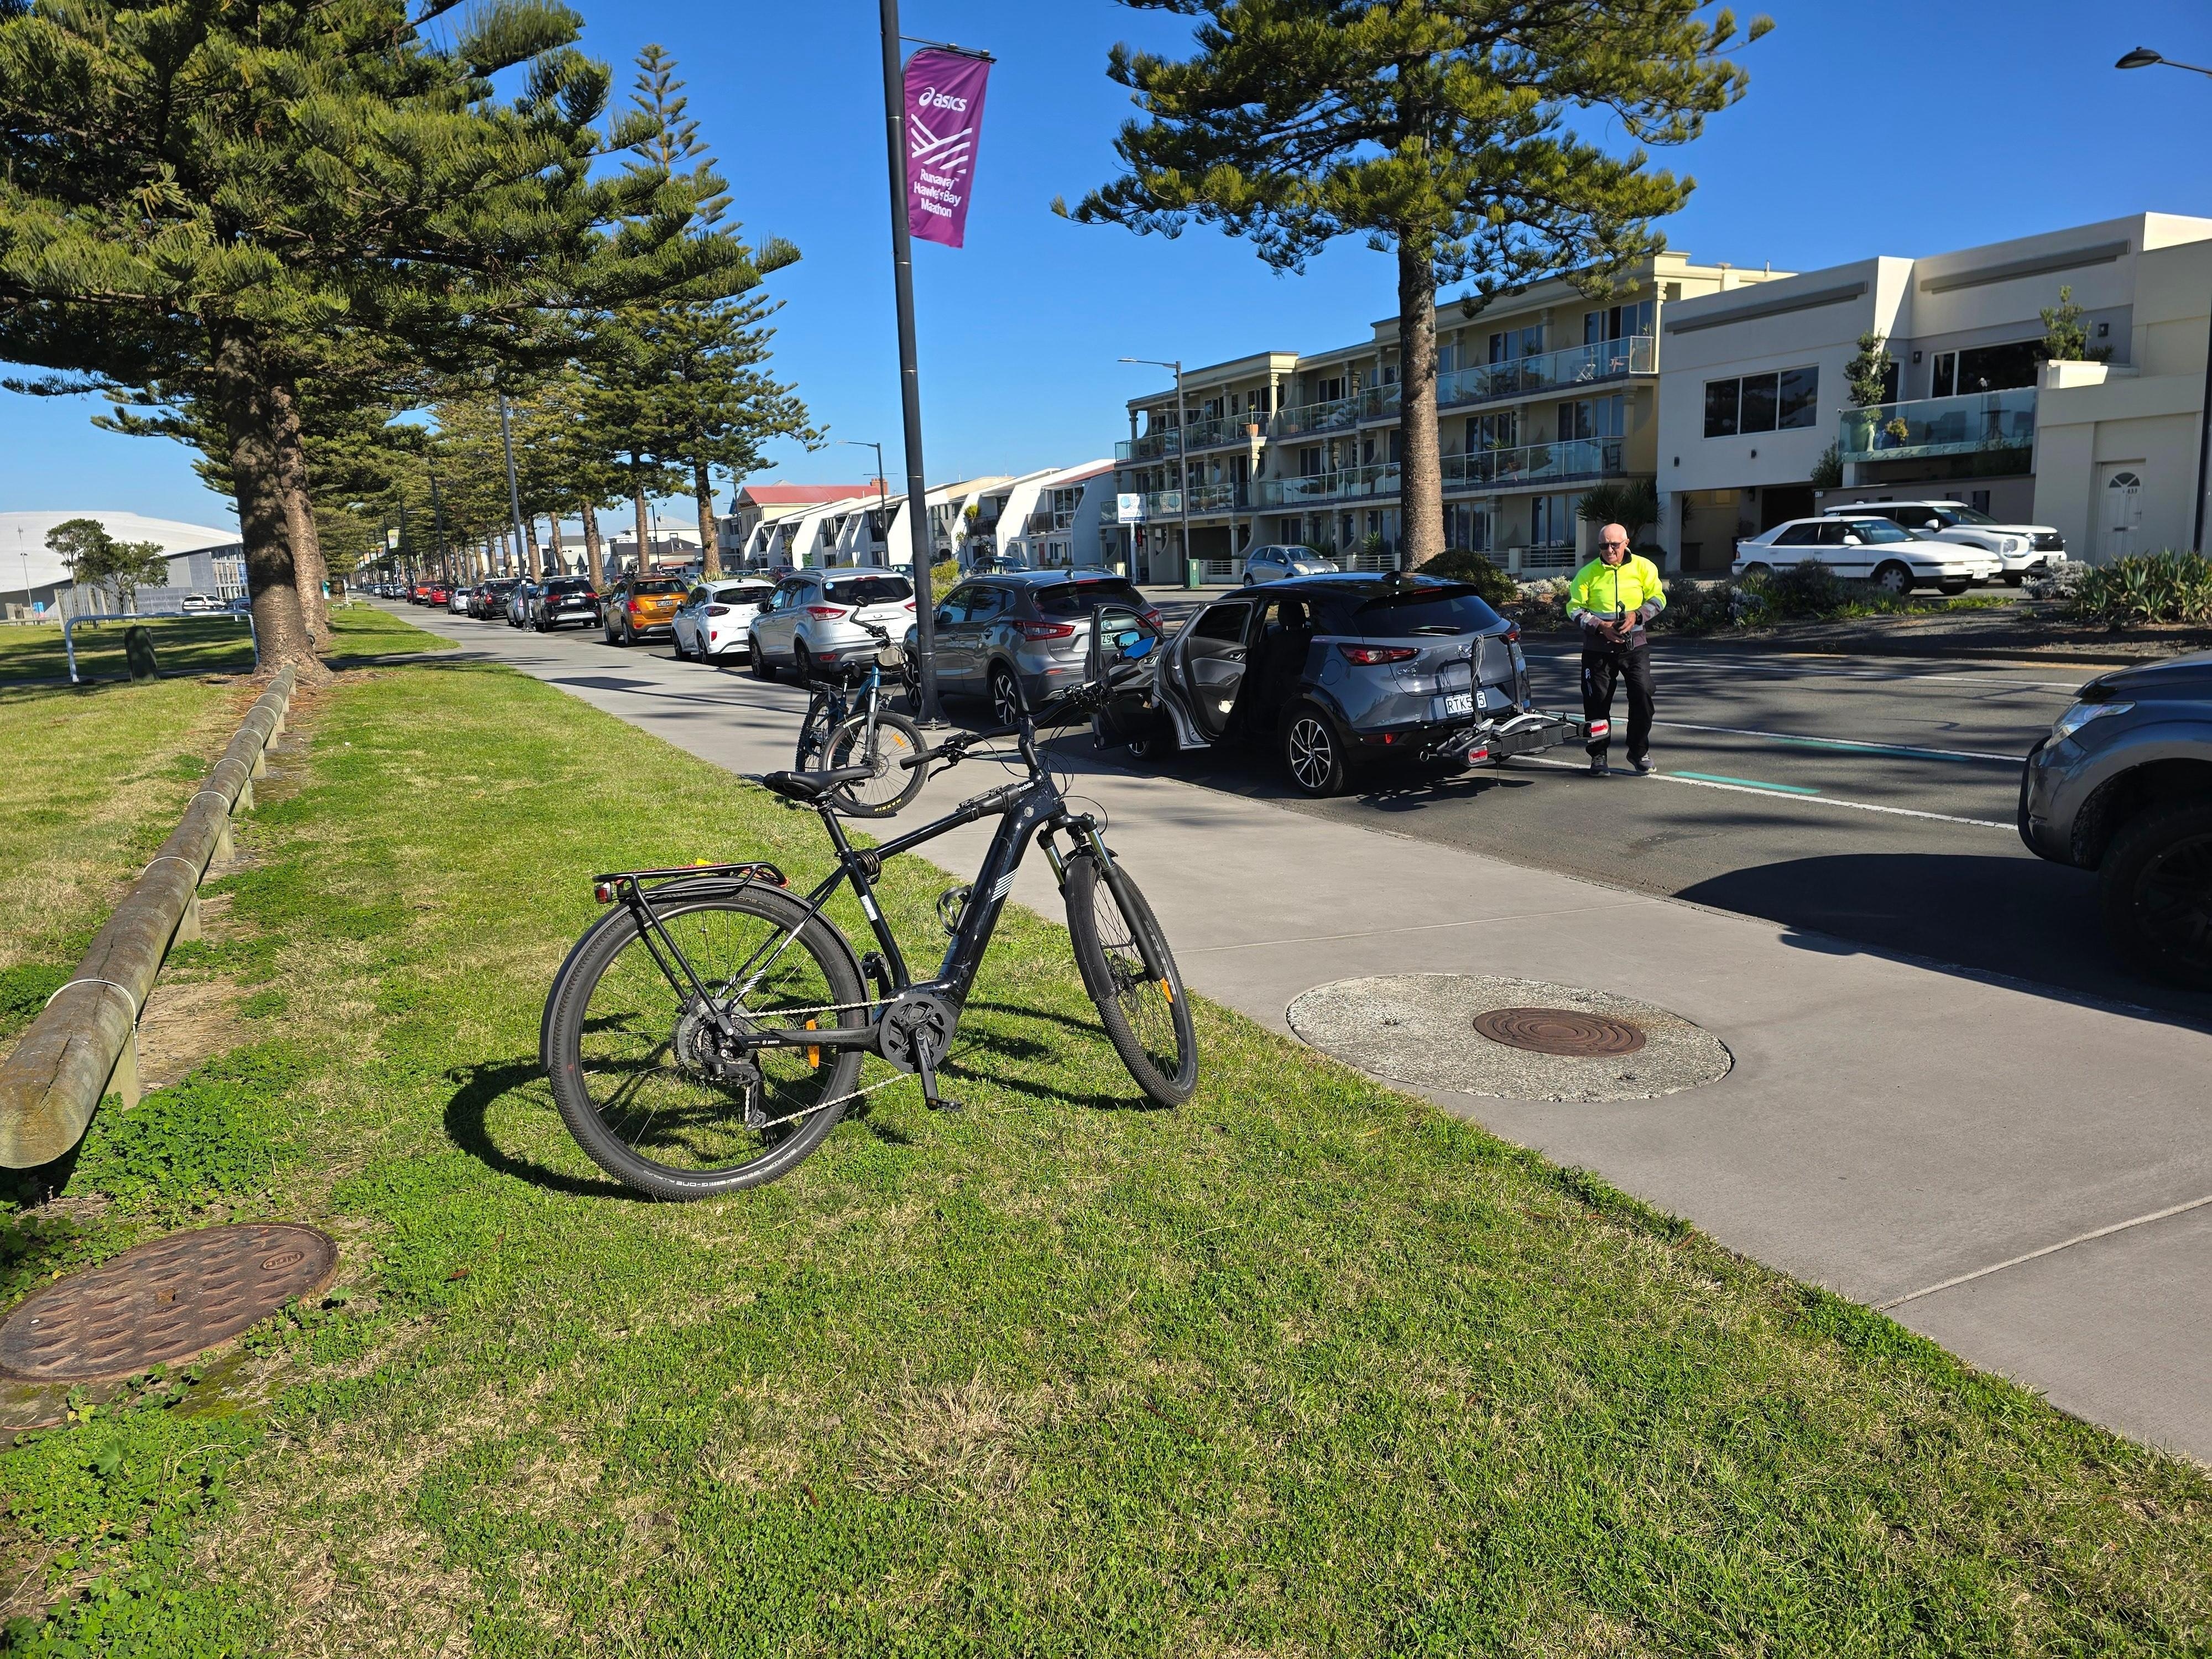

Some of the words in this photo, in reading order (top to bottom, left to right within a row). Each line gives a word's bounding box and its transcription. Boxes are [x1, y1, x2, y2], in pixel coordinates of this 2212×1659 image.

[921, 197, 952, 218] Maathon
[943, 190, 962, 207] Bay
[1447, 694, 1485, 712] RTK55
